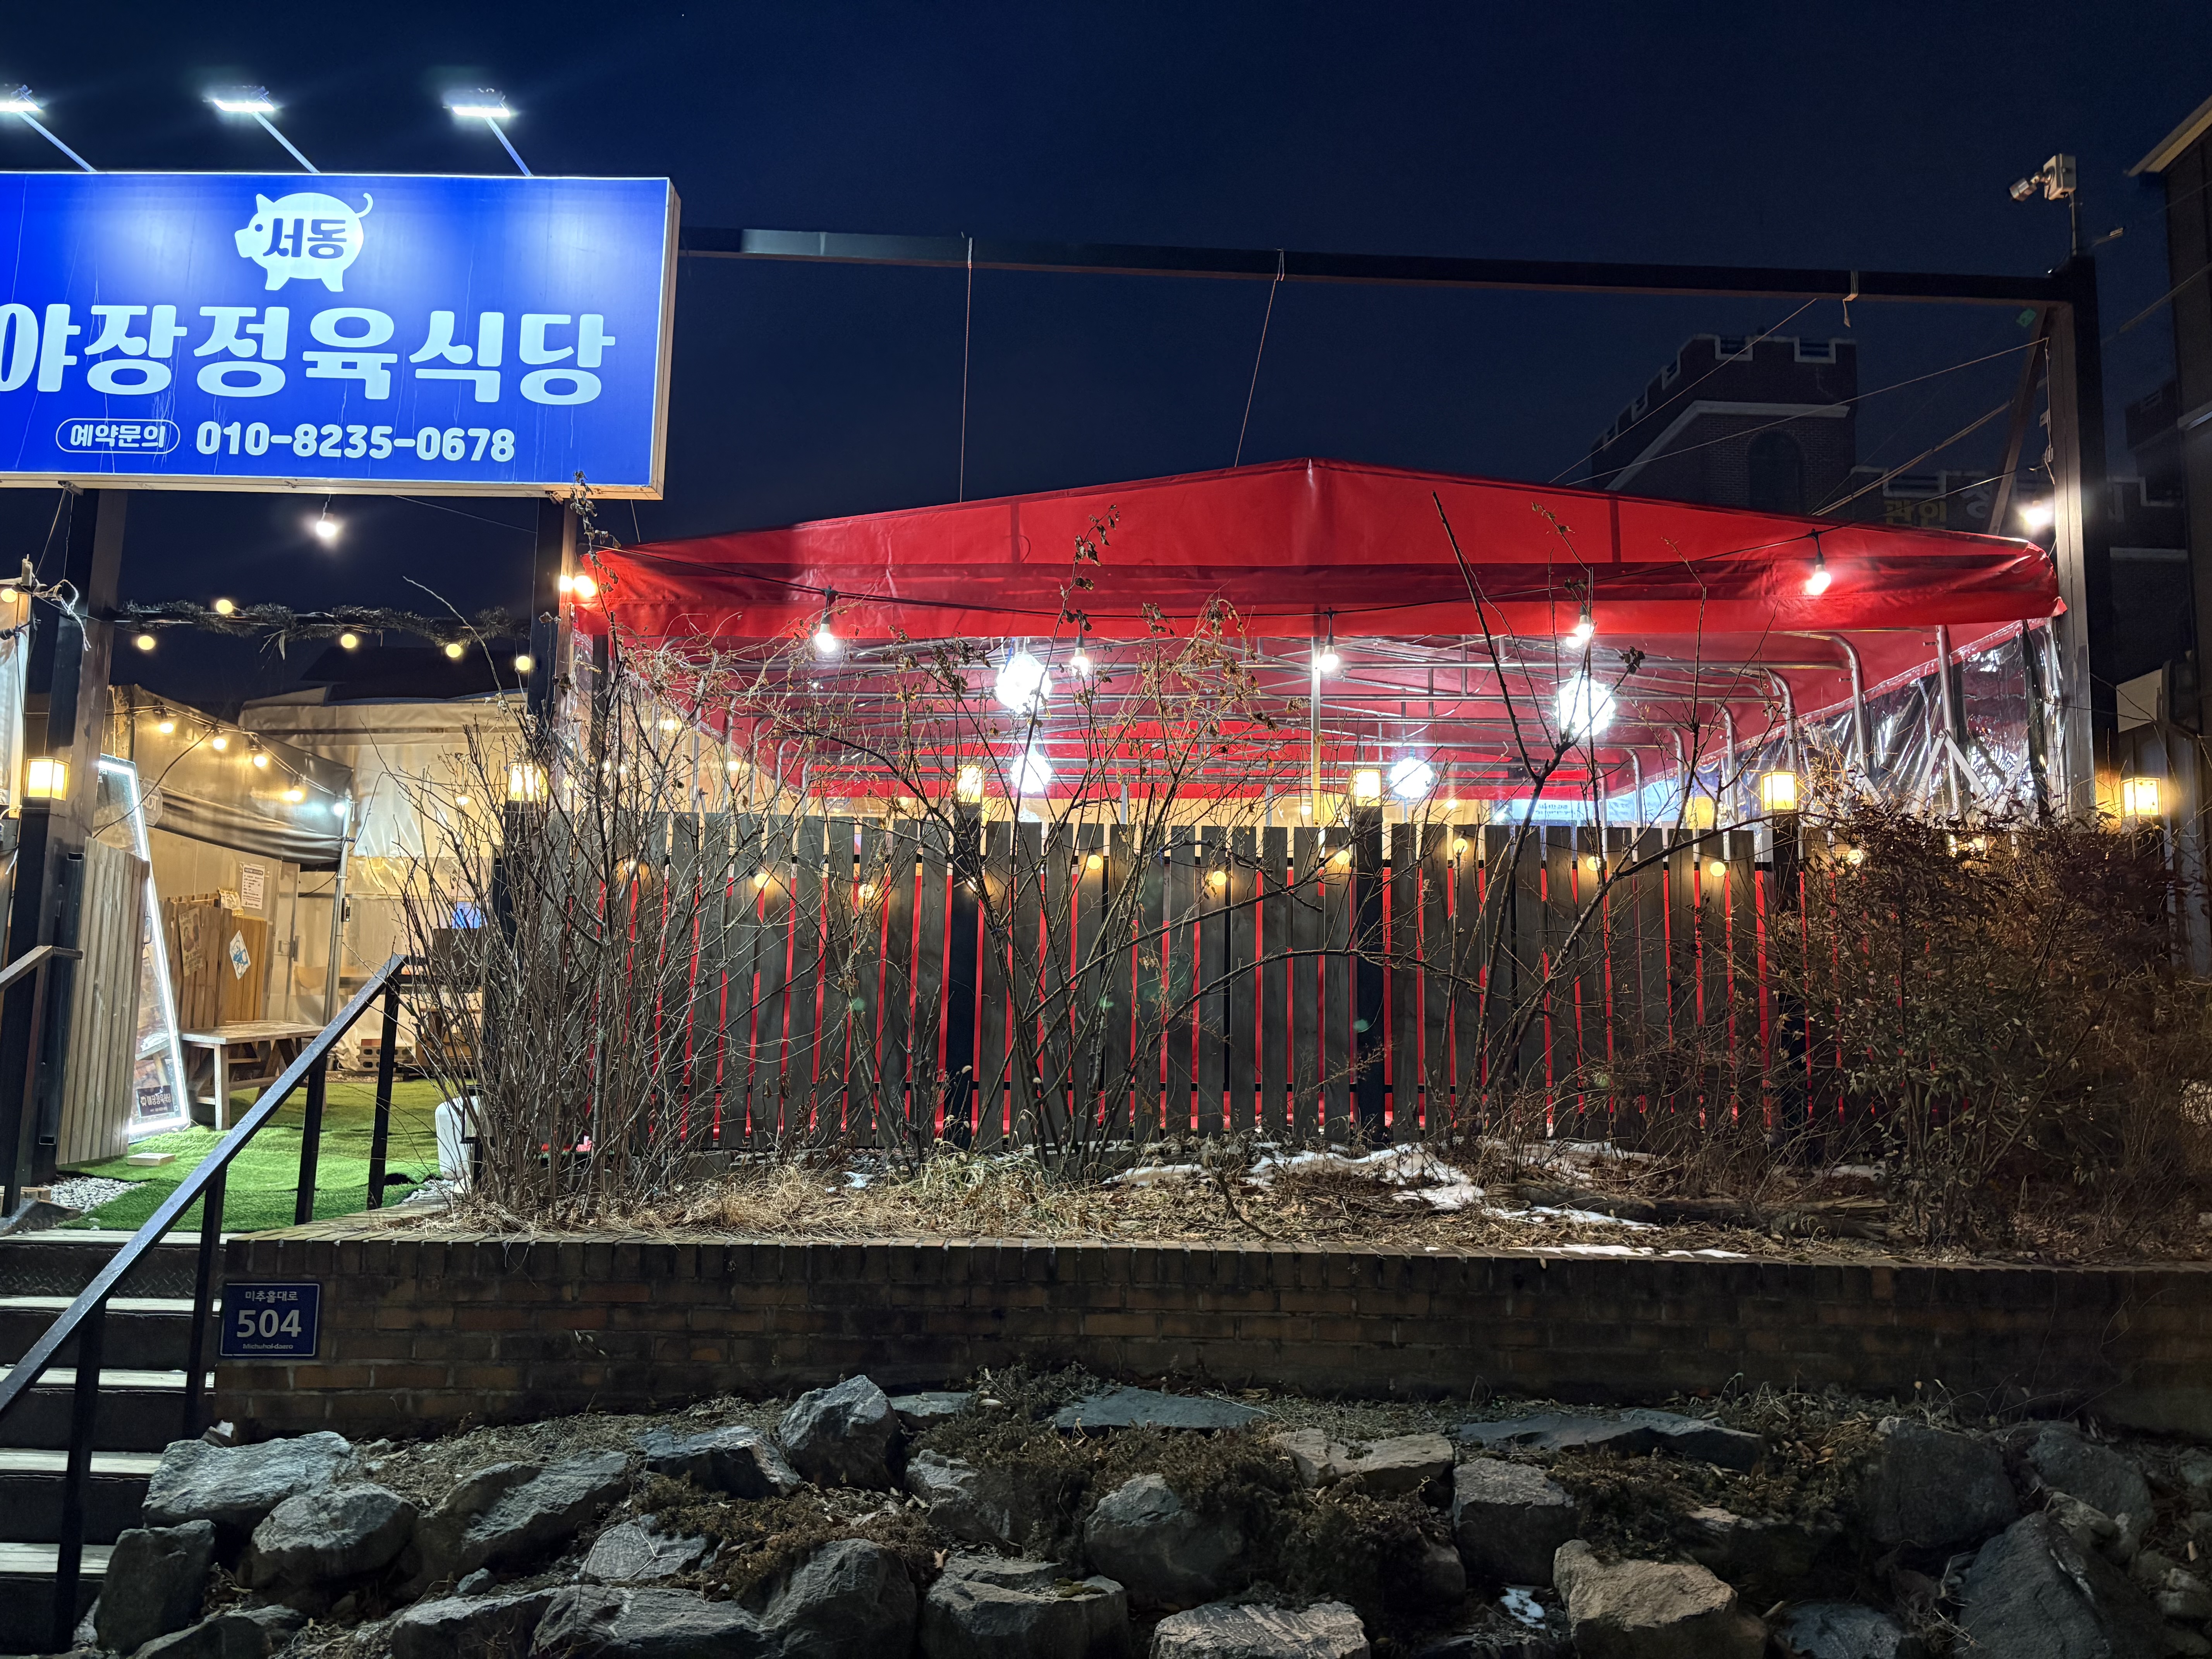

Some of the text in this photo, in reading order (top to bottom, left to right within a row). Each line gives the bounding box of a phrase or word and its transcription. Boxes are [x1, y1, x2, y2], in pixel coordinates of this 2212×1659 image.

[263, 218, 347, 259] 서동
[0, 303, 615, 405] 야장정육식당
[70, 424, 166, 448] 예약문의
[196, 421, 515, 462] 010-8235-0678
[245, 1291, 298, 1303] 미추홀대로
[237, 1309, 302, 1338] 504
